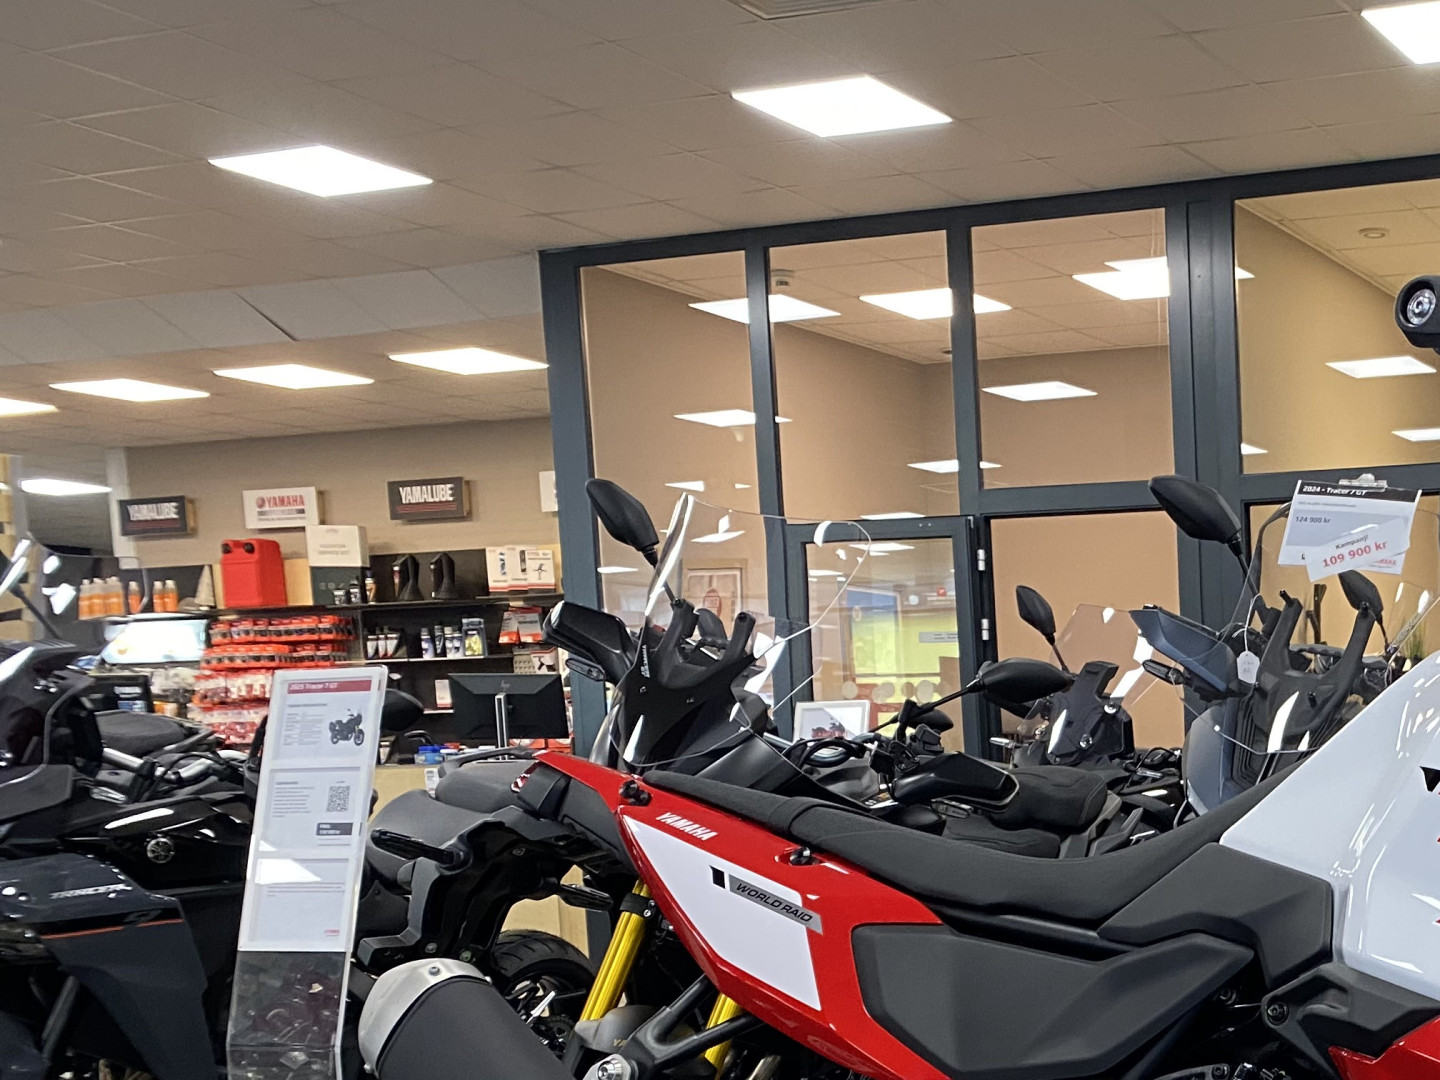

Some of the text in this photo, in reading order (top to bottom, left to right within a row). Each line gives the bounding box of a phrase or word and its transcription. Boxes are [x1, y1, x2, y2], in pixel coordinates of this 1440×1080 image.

[399, 483, 455, 504] YAMALUBE
[1302, 485, 1321, 493] 2024
[1326, 487, 1349, 495] Tracer
[266, 494, 305, 508] YAMAHA
[127, 502, 179, 521] YAMALUBE
[1295, 515, 1308, 523] 124
[1322, 553, 1345, 568] 109
[1348, 546, 1372, 560] 900
[1374, 541, 1388, 550] kr
[655, 812, 719, 841] YAMAHA
[735, 882, 813, 923] WORLD RAID
